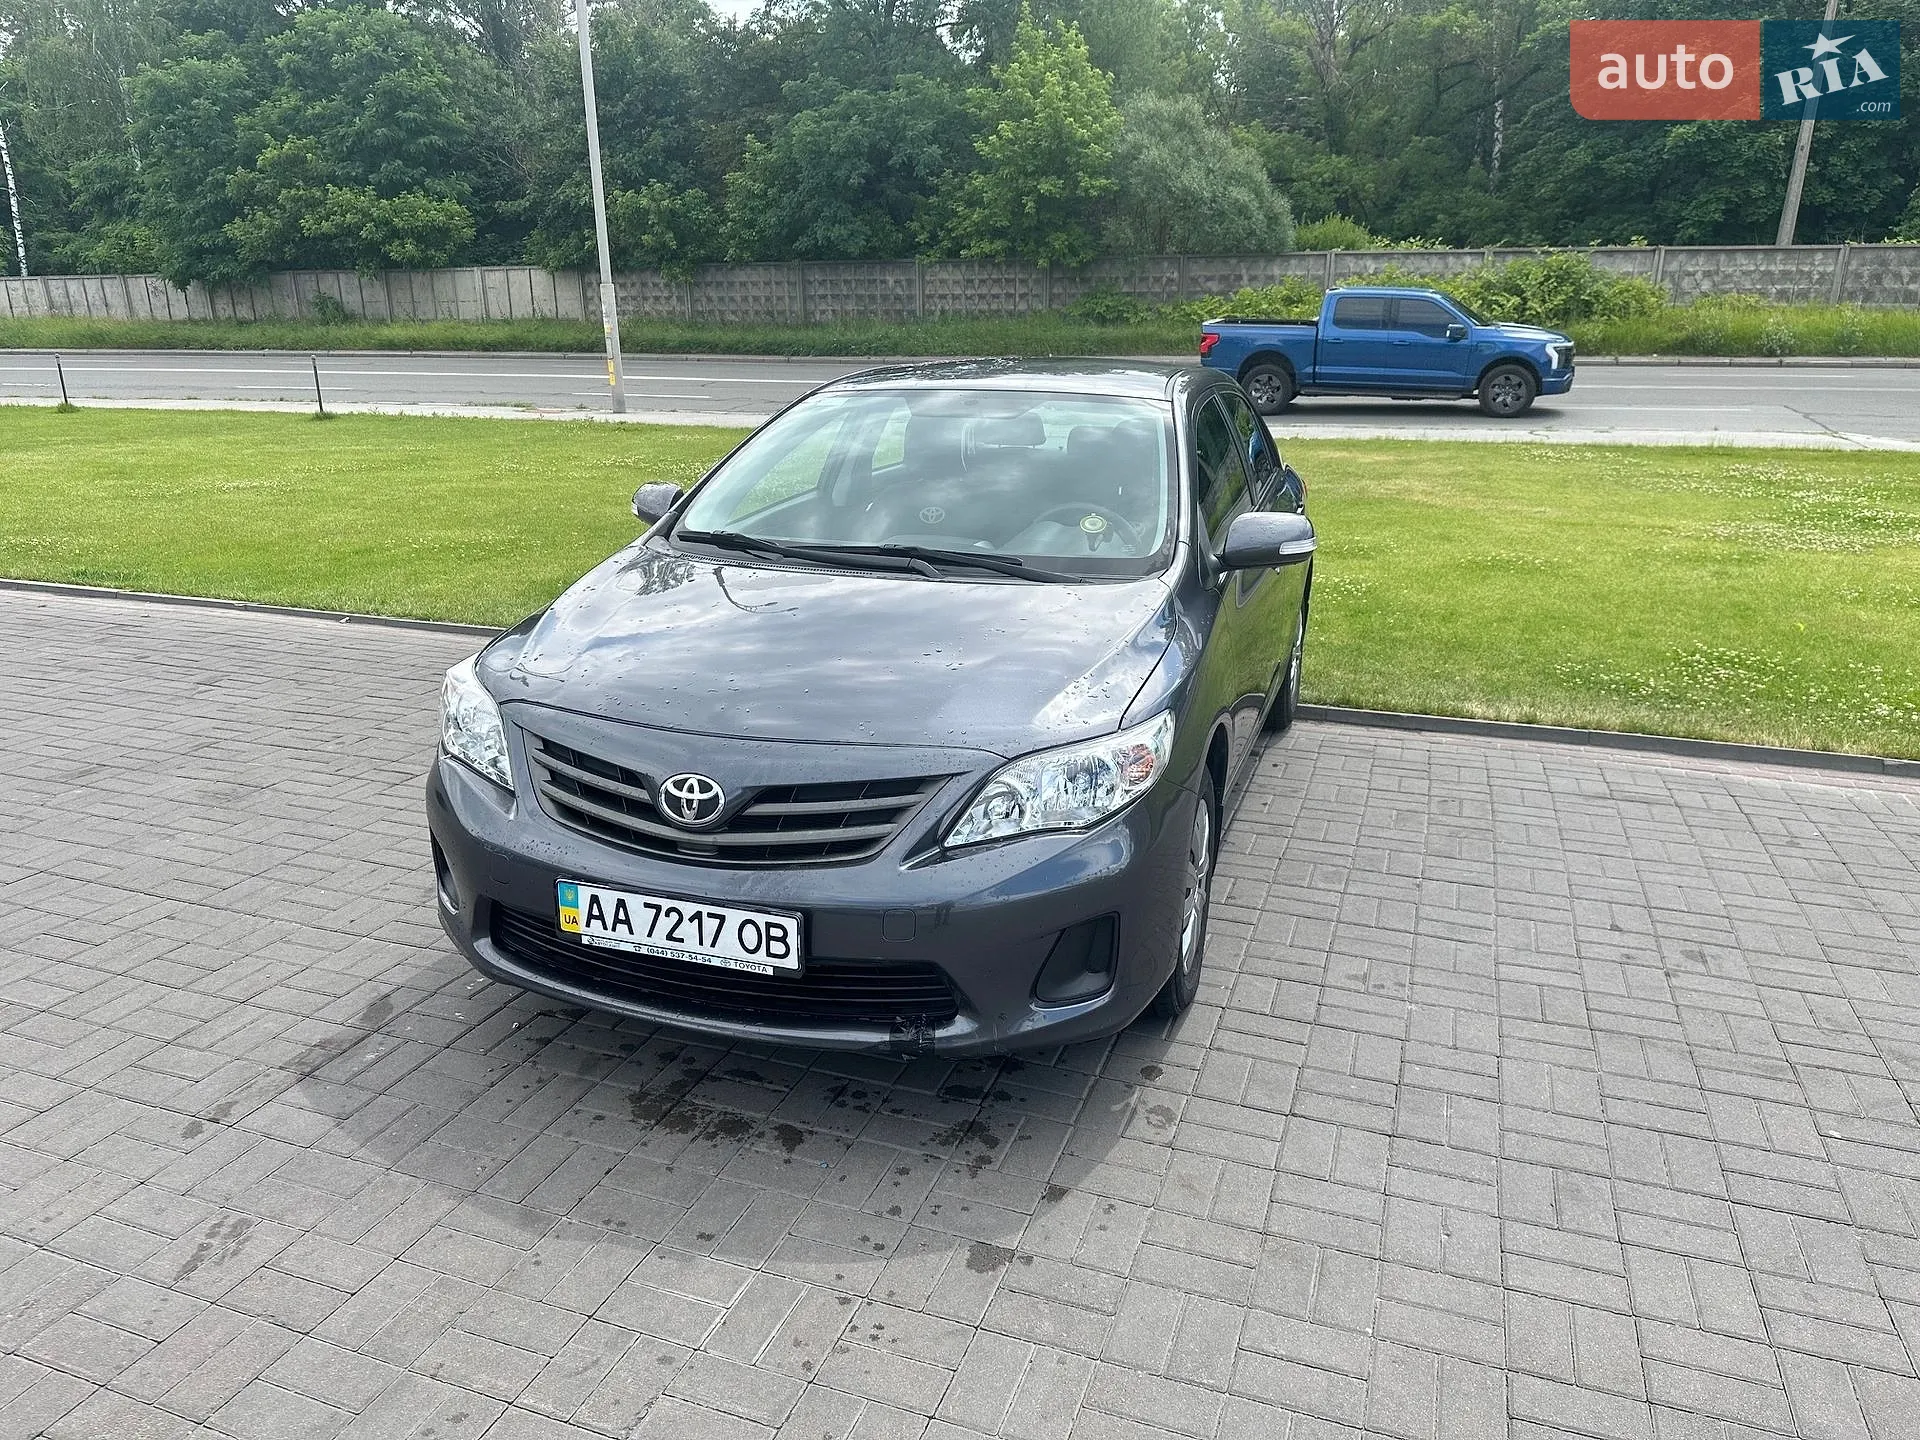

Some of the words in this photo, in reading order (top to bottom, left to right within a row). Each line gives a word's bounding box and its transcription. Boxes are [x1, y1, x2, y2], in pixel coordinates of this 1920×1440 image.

[564, 914, 579, 926] UA
[585, 893, 635, 936] AA
[643, 901, 727, 949] 7217
[737, 918, 791, 960] OB
[646, 947, 668, 957] (044)
[670, 951, 712, 964] 537-54-54
[734, 961, 768, 973] TOYOTA
